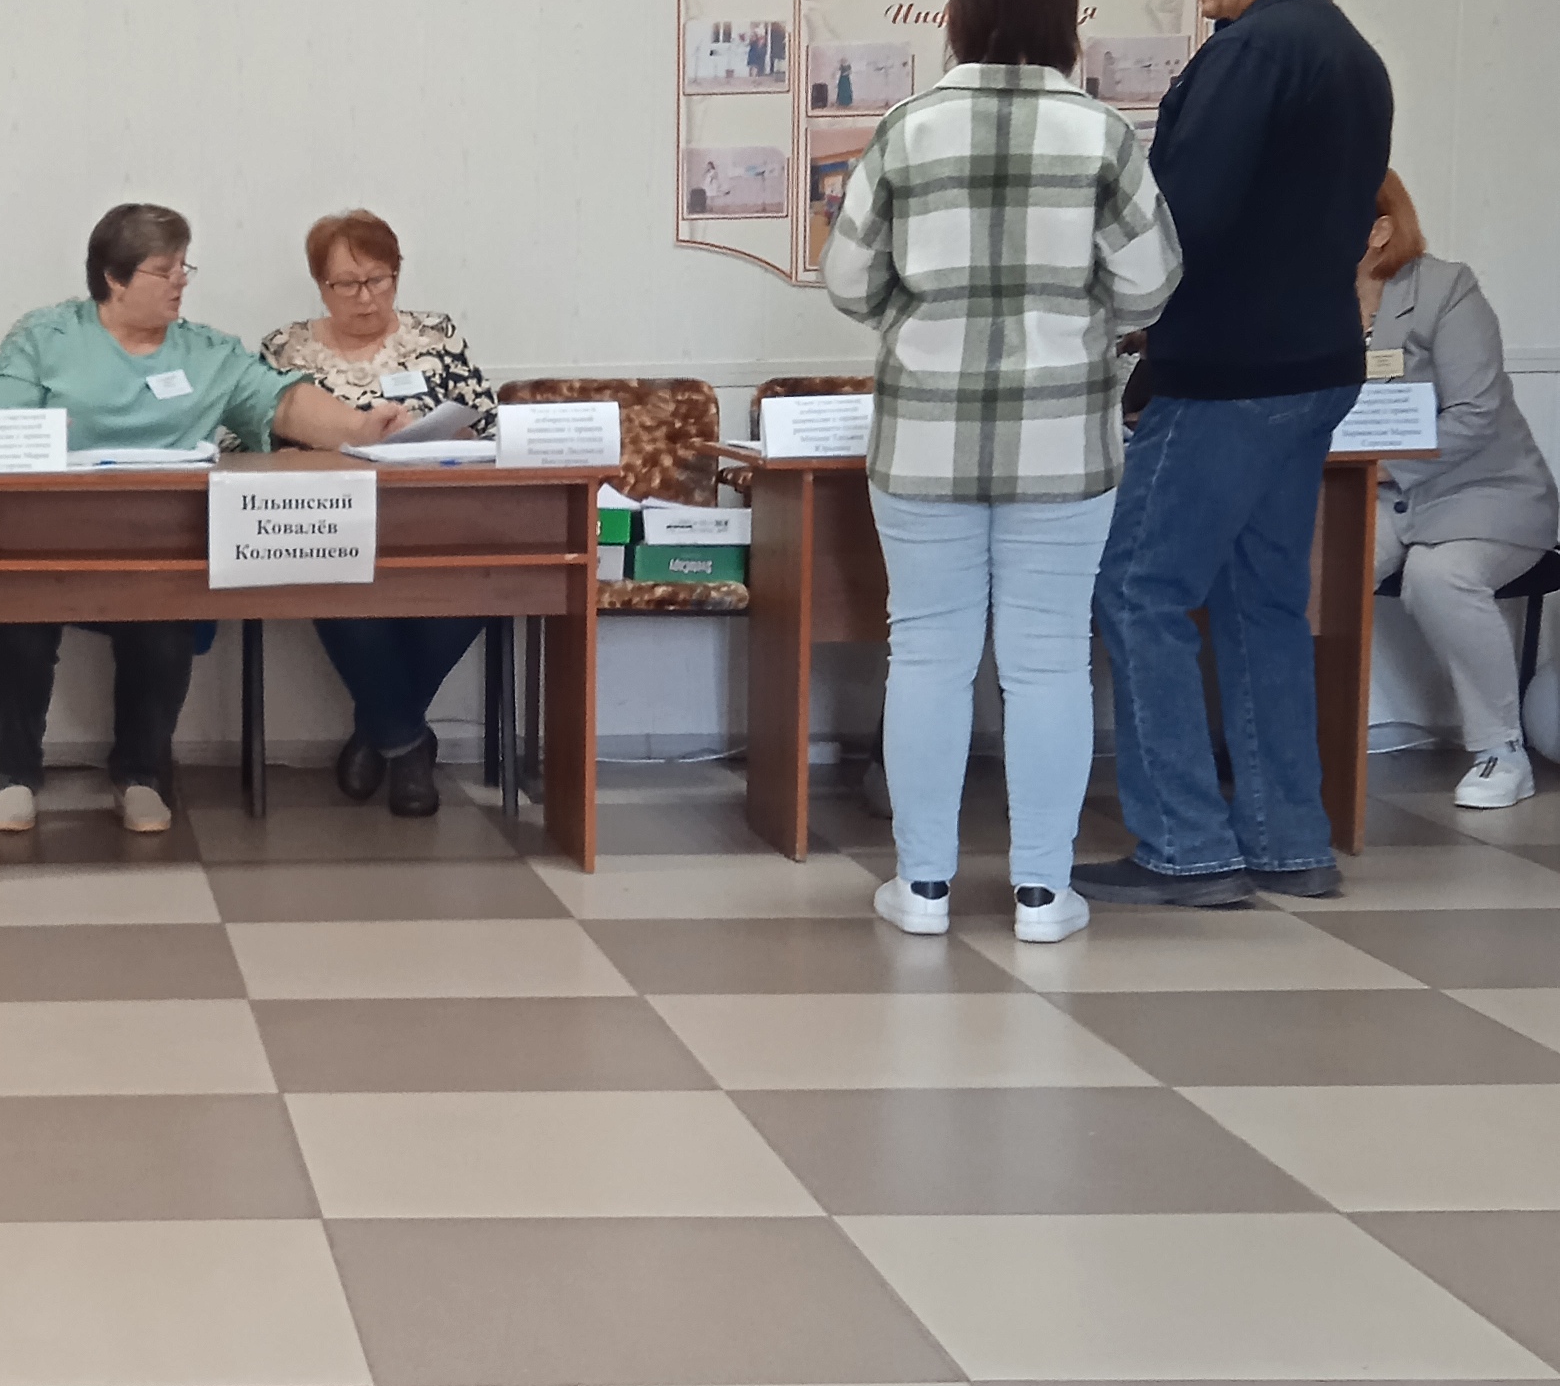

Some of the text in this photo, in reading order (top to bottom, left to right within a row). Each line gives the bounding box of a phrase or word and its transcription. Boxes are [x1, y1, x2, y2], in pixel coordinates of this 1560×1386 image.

[241, 494, 353, 511] Ильинский
[256, 519, 339, 535] Ковалёв
[235, 543, 360, 561] Коломыцево
